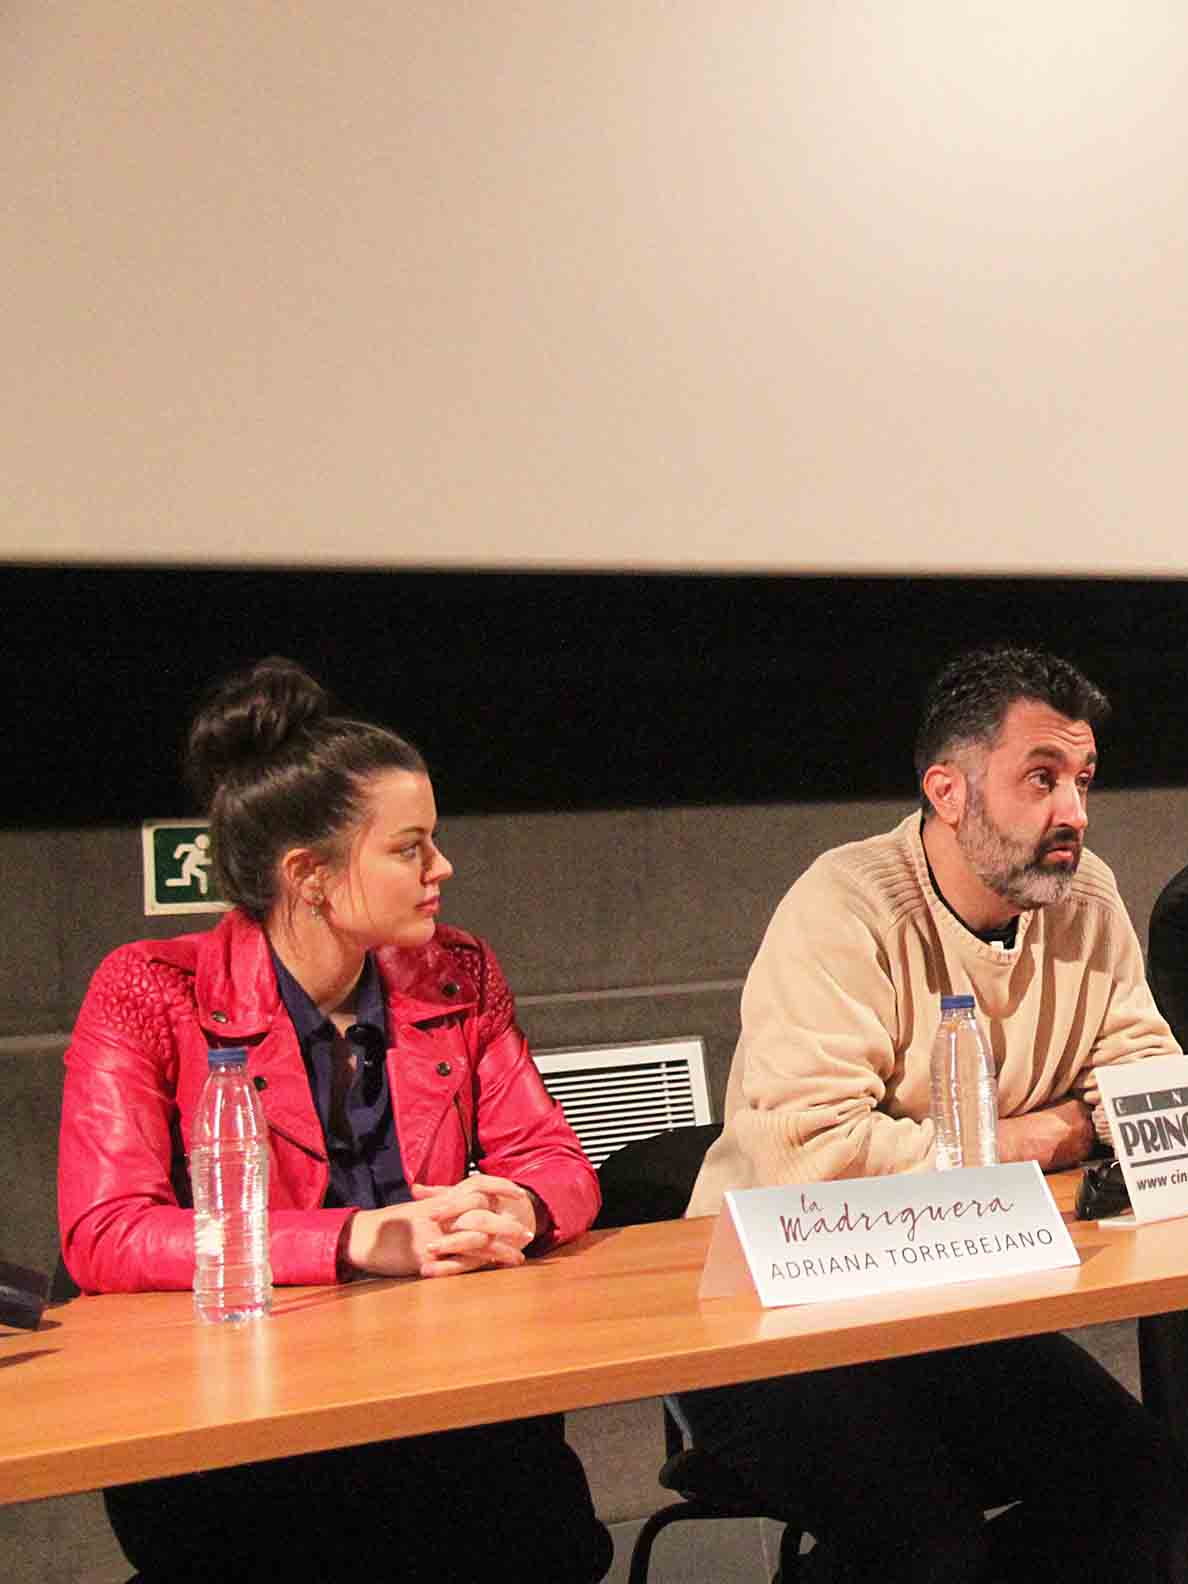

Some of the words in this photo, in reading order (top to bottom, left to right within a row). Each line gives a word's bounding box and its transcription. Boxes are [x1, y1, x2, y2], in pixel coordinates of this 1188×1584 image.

[779, 1194, 1015, 1243] Madriguera
[800, 1192, 824, 1213] la
[770, 1250, 879, 1280] ADRIANA
[885, 1227, 1054, 1265] TORREBEJANO
